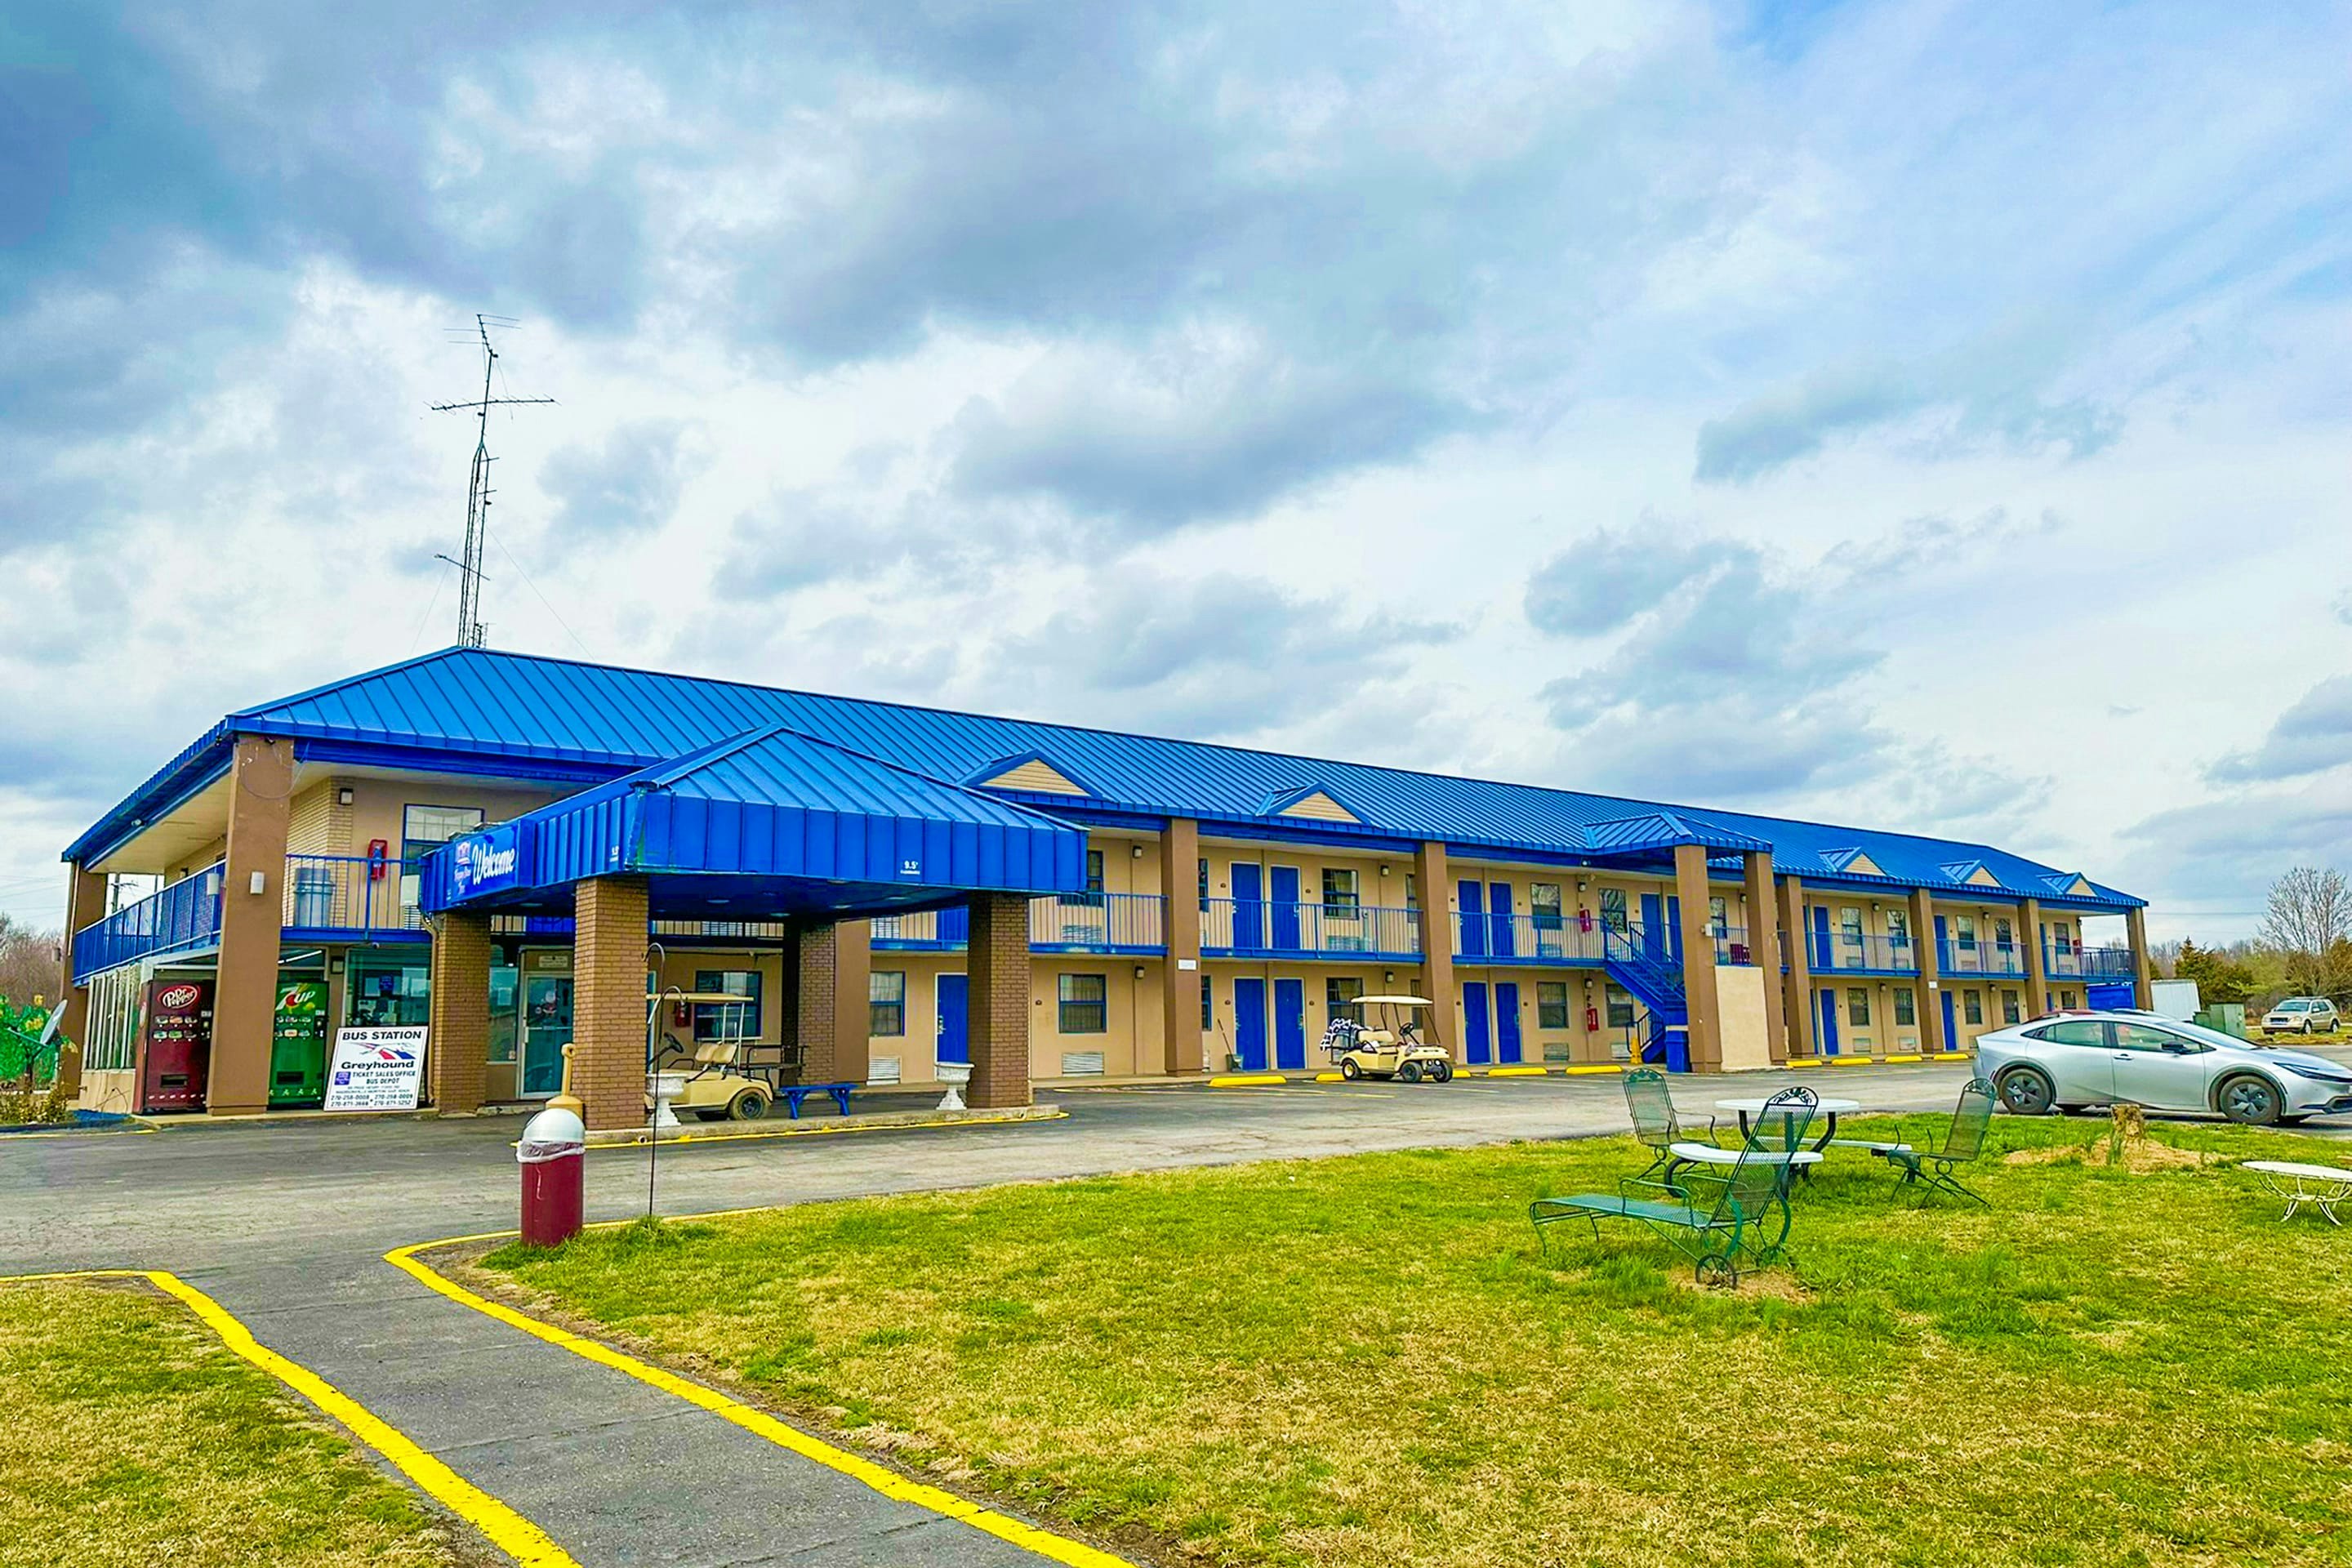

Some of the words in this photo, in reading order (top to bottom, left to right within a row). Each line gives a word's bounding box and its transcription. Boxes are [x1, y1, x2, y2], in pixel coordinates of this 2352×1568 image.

[472, 842, 515, 885] Welcome
[163, 990, 196, 1007] Pepper
[342, 1031, 368, 1040] BUS
[372, 1031, 422, 1040] STATION
[341, 1061, 415, 1071] Greyhound
